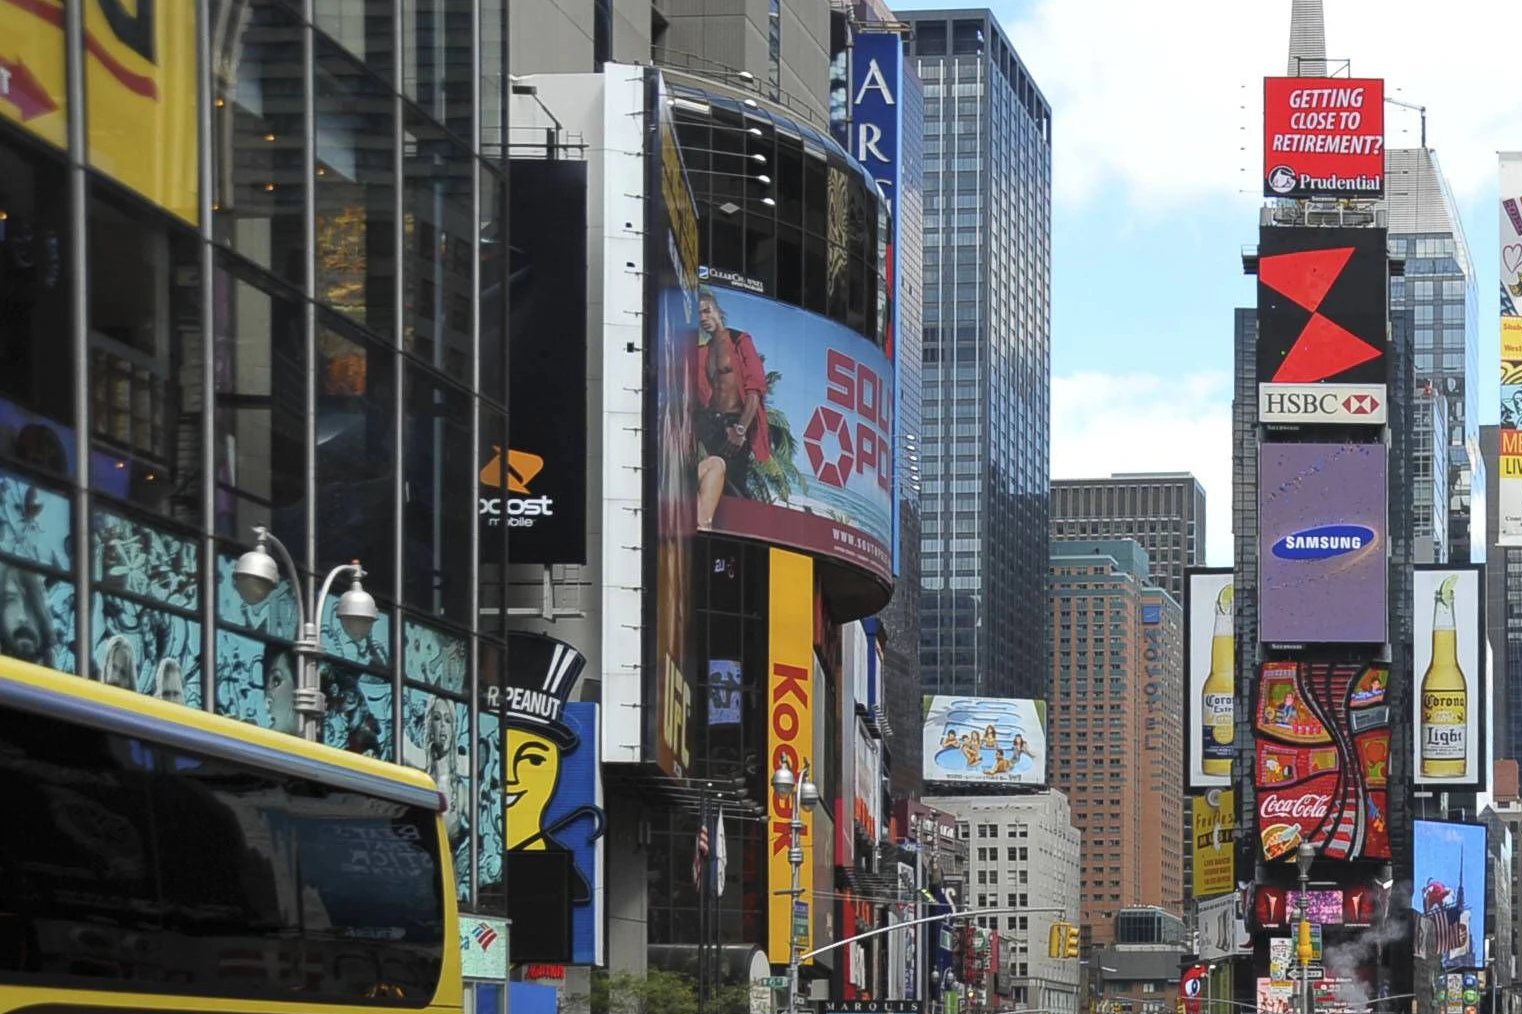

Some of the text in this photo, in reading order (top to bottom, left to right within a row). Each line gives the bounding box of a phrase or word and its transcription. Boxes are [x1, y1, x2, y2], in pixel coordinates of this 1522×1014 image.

[1289, 88, 1364, 108] GETTING
[1290, 112, 1361, 129] CLOSE TO
[1272, 134, 1384, 154] RETIREMENT?
[1300, 174, 1381, 190] Prudential
[1504, 344, 1522, 352] West
[1264, 393, 1338, 414] HSBC
[1285, 534, 1362, 549] SAMSUNG
[506, 686, 560, 720] PEANUT
[1260, 794, 1333, 818] Coca-Cola
